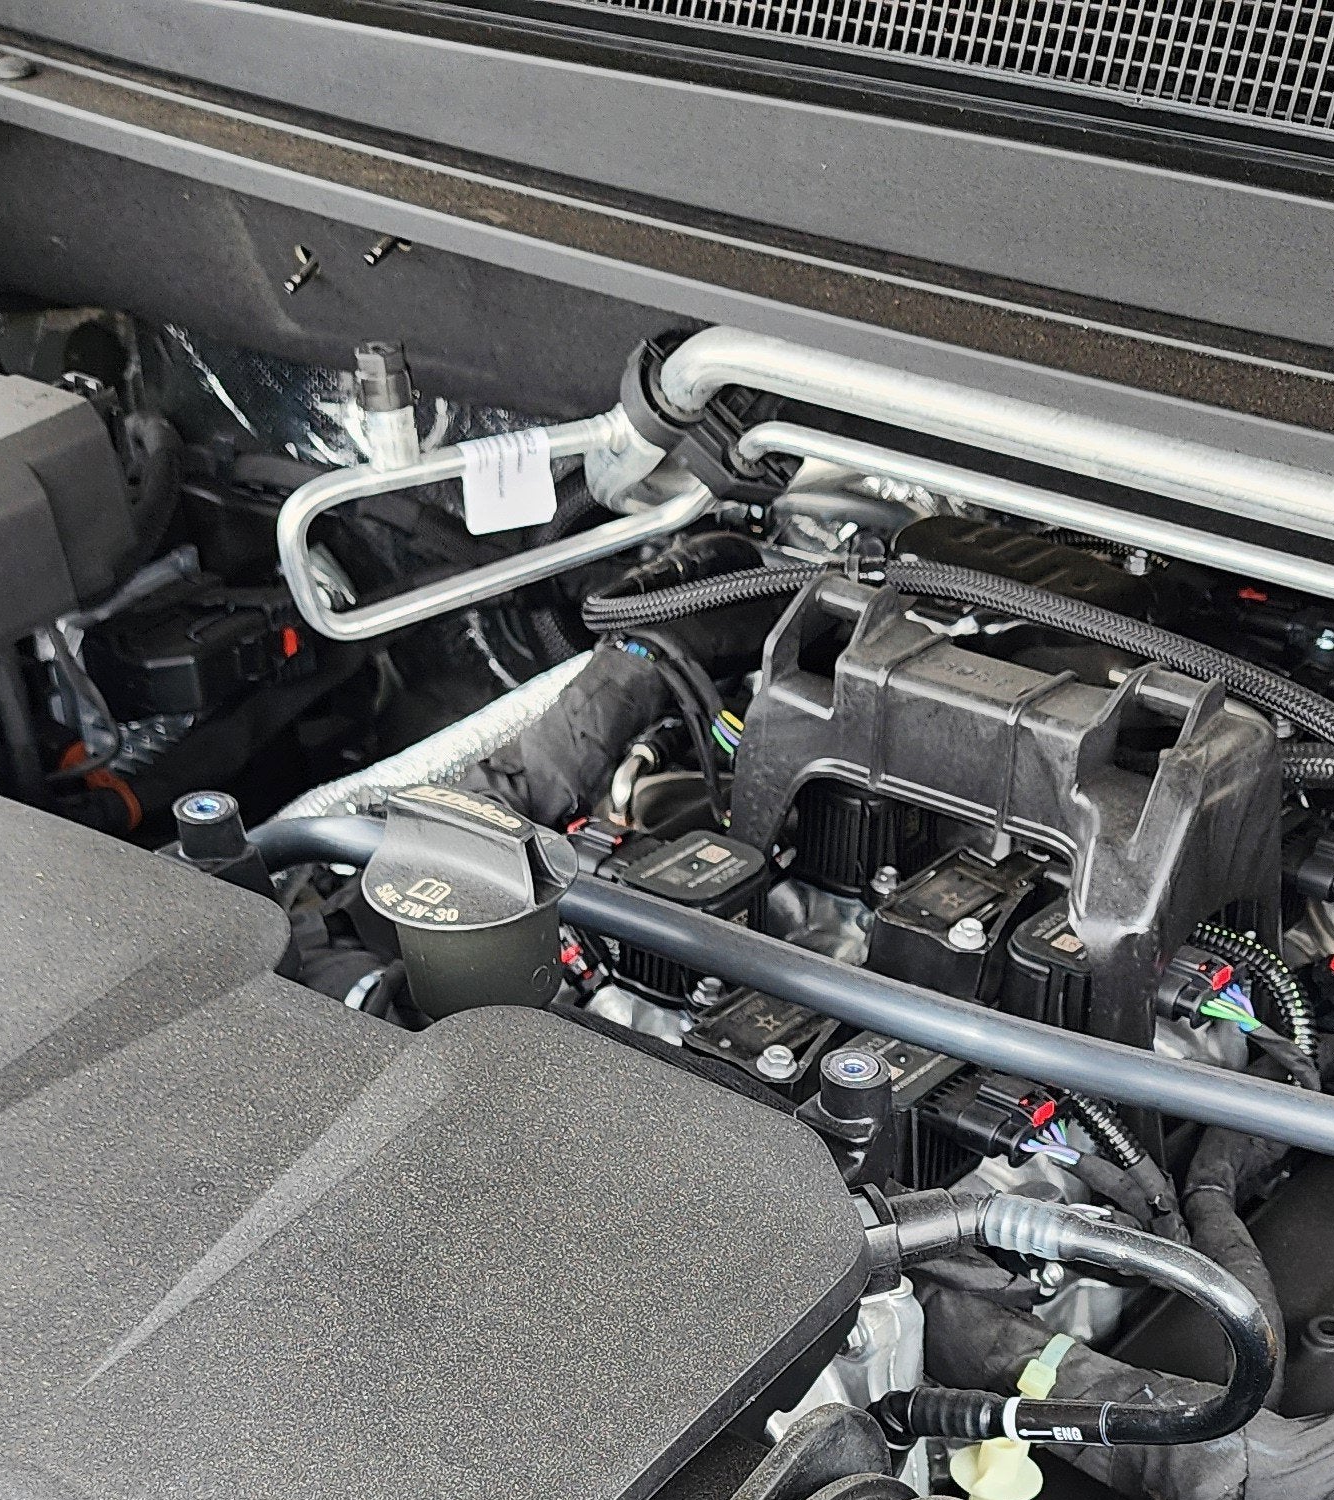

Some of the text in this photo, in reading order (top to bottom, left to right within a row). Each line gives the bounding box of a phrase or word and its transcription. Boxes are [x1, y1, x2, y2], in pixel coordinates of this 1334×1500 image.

[404, 785, 523, 830] ACDelco
[375, 882, 460, 922] SAE 5W-30
